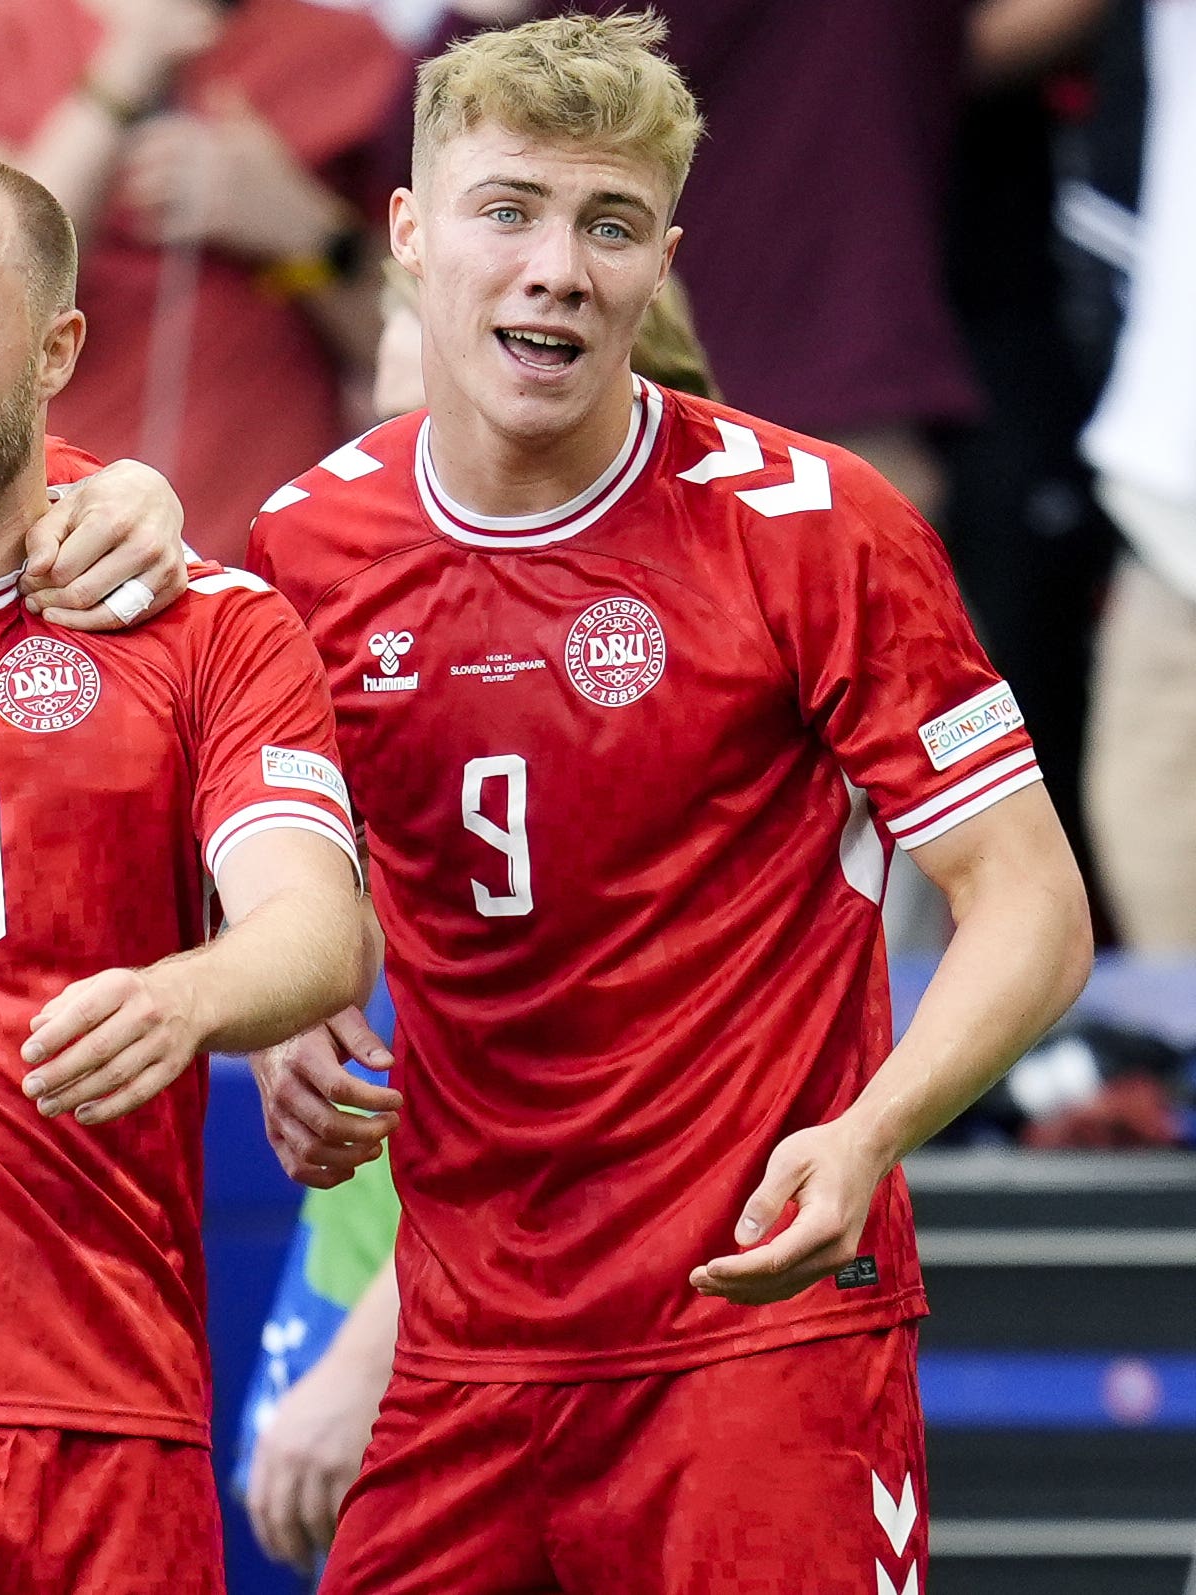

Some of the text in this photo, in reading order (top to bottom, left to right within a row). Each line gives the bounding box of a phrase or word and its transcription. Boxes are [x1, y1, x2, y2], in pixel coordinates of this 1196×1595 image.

[569, 631, 596, 693] DANSK
[640, 627, 663, 686] UNION
[587, 633, 647, 667] DBU
[450, 659, 546, 676] SLOVENIA vs DENMARK
[10, 666, 78, 700] DBU
[76, 661, 97, 712] UNION
[362, 672, 419, 692] hummel
[598, 685, 638, 704] 1889
[30, 712, 74, 730] 1889
[923, 720, 947, 740] UEFA
[266, 748, 296, 761] UEFA
[461, 753, 534, 918] 9
